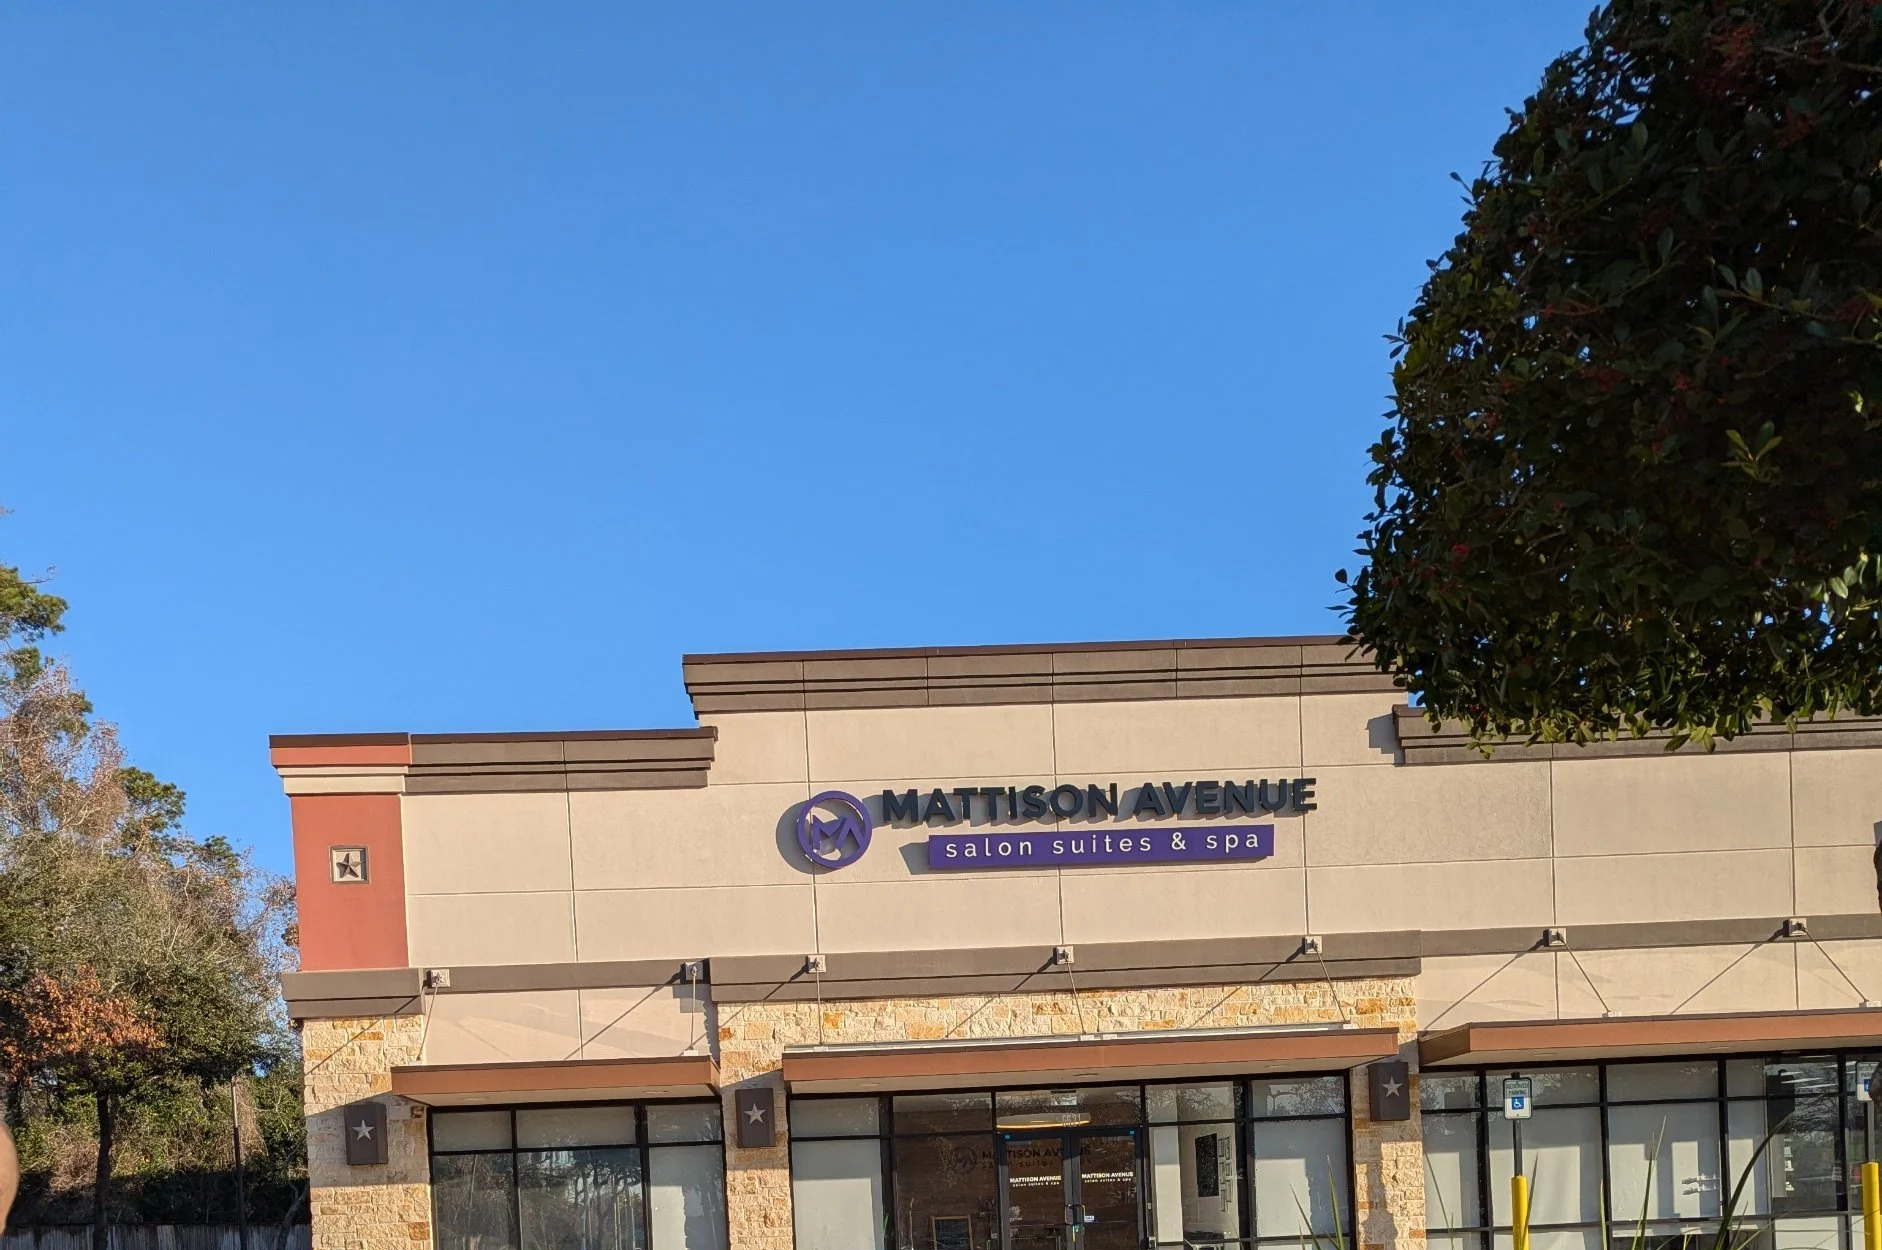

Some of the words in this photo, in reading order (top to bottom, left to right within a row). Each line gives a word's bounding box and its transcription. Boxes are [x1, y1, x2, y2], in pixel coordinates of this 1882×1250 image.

[882, 783, 1119, 823] MATTISON
[1133, 777, 1318, 816] AVENUE
[945, 837, 1032, 858] salon
[1052, 834, 1151, 855] suites
[1171, 831, 1186, 850] &
[1206, 833, 1259, 853] spa
